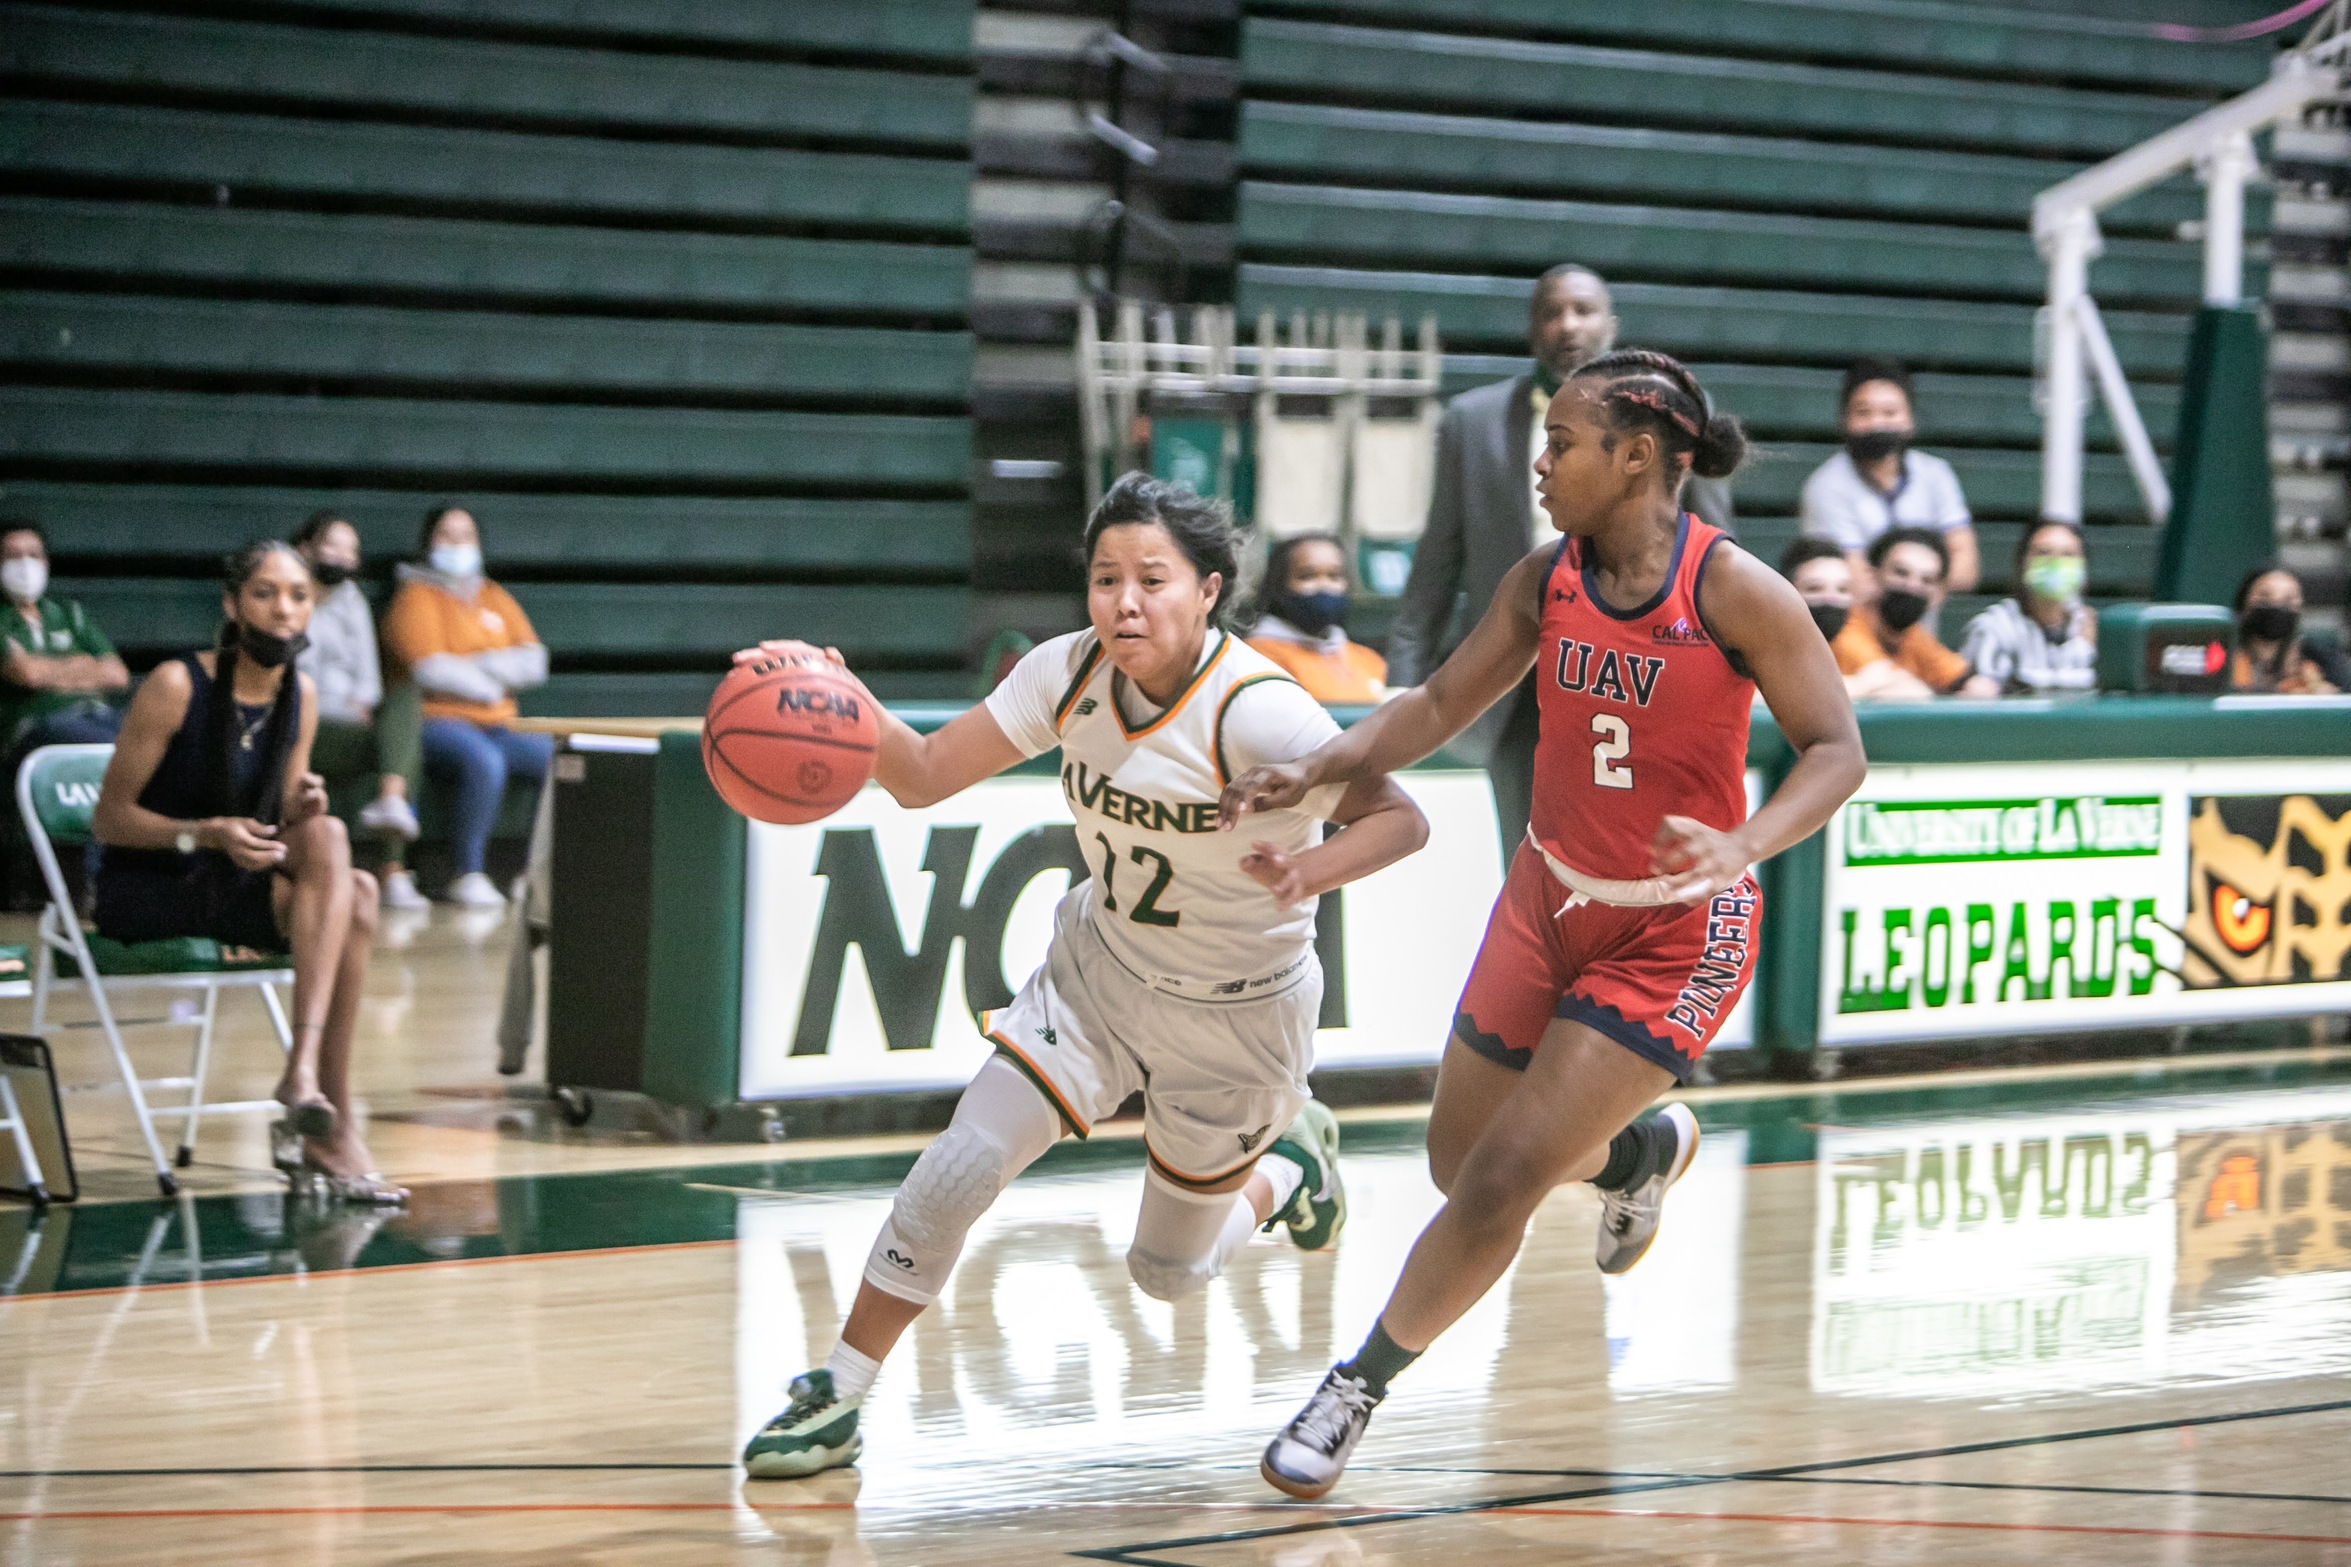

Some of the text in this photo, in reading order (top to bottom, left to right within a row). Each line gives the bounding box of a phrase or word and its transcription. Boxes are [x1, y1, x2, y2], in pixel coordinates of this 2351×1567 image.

[1652, 625, 1709, 641] CAL PAC
[777, 688, 860, 721] NCAA
[1556, 637, 1665, 707] UAV
[1591, 713, 1634, 789] 2
[1095, 831, 1180, 928] 12
[1249, 976, 1273, 988] new
[1274, 955, 1308, 980] balan
[1838, 898, 2157, 1014] LEOPARDS
